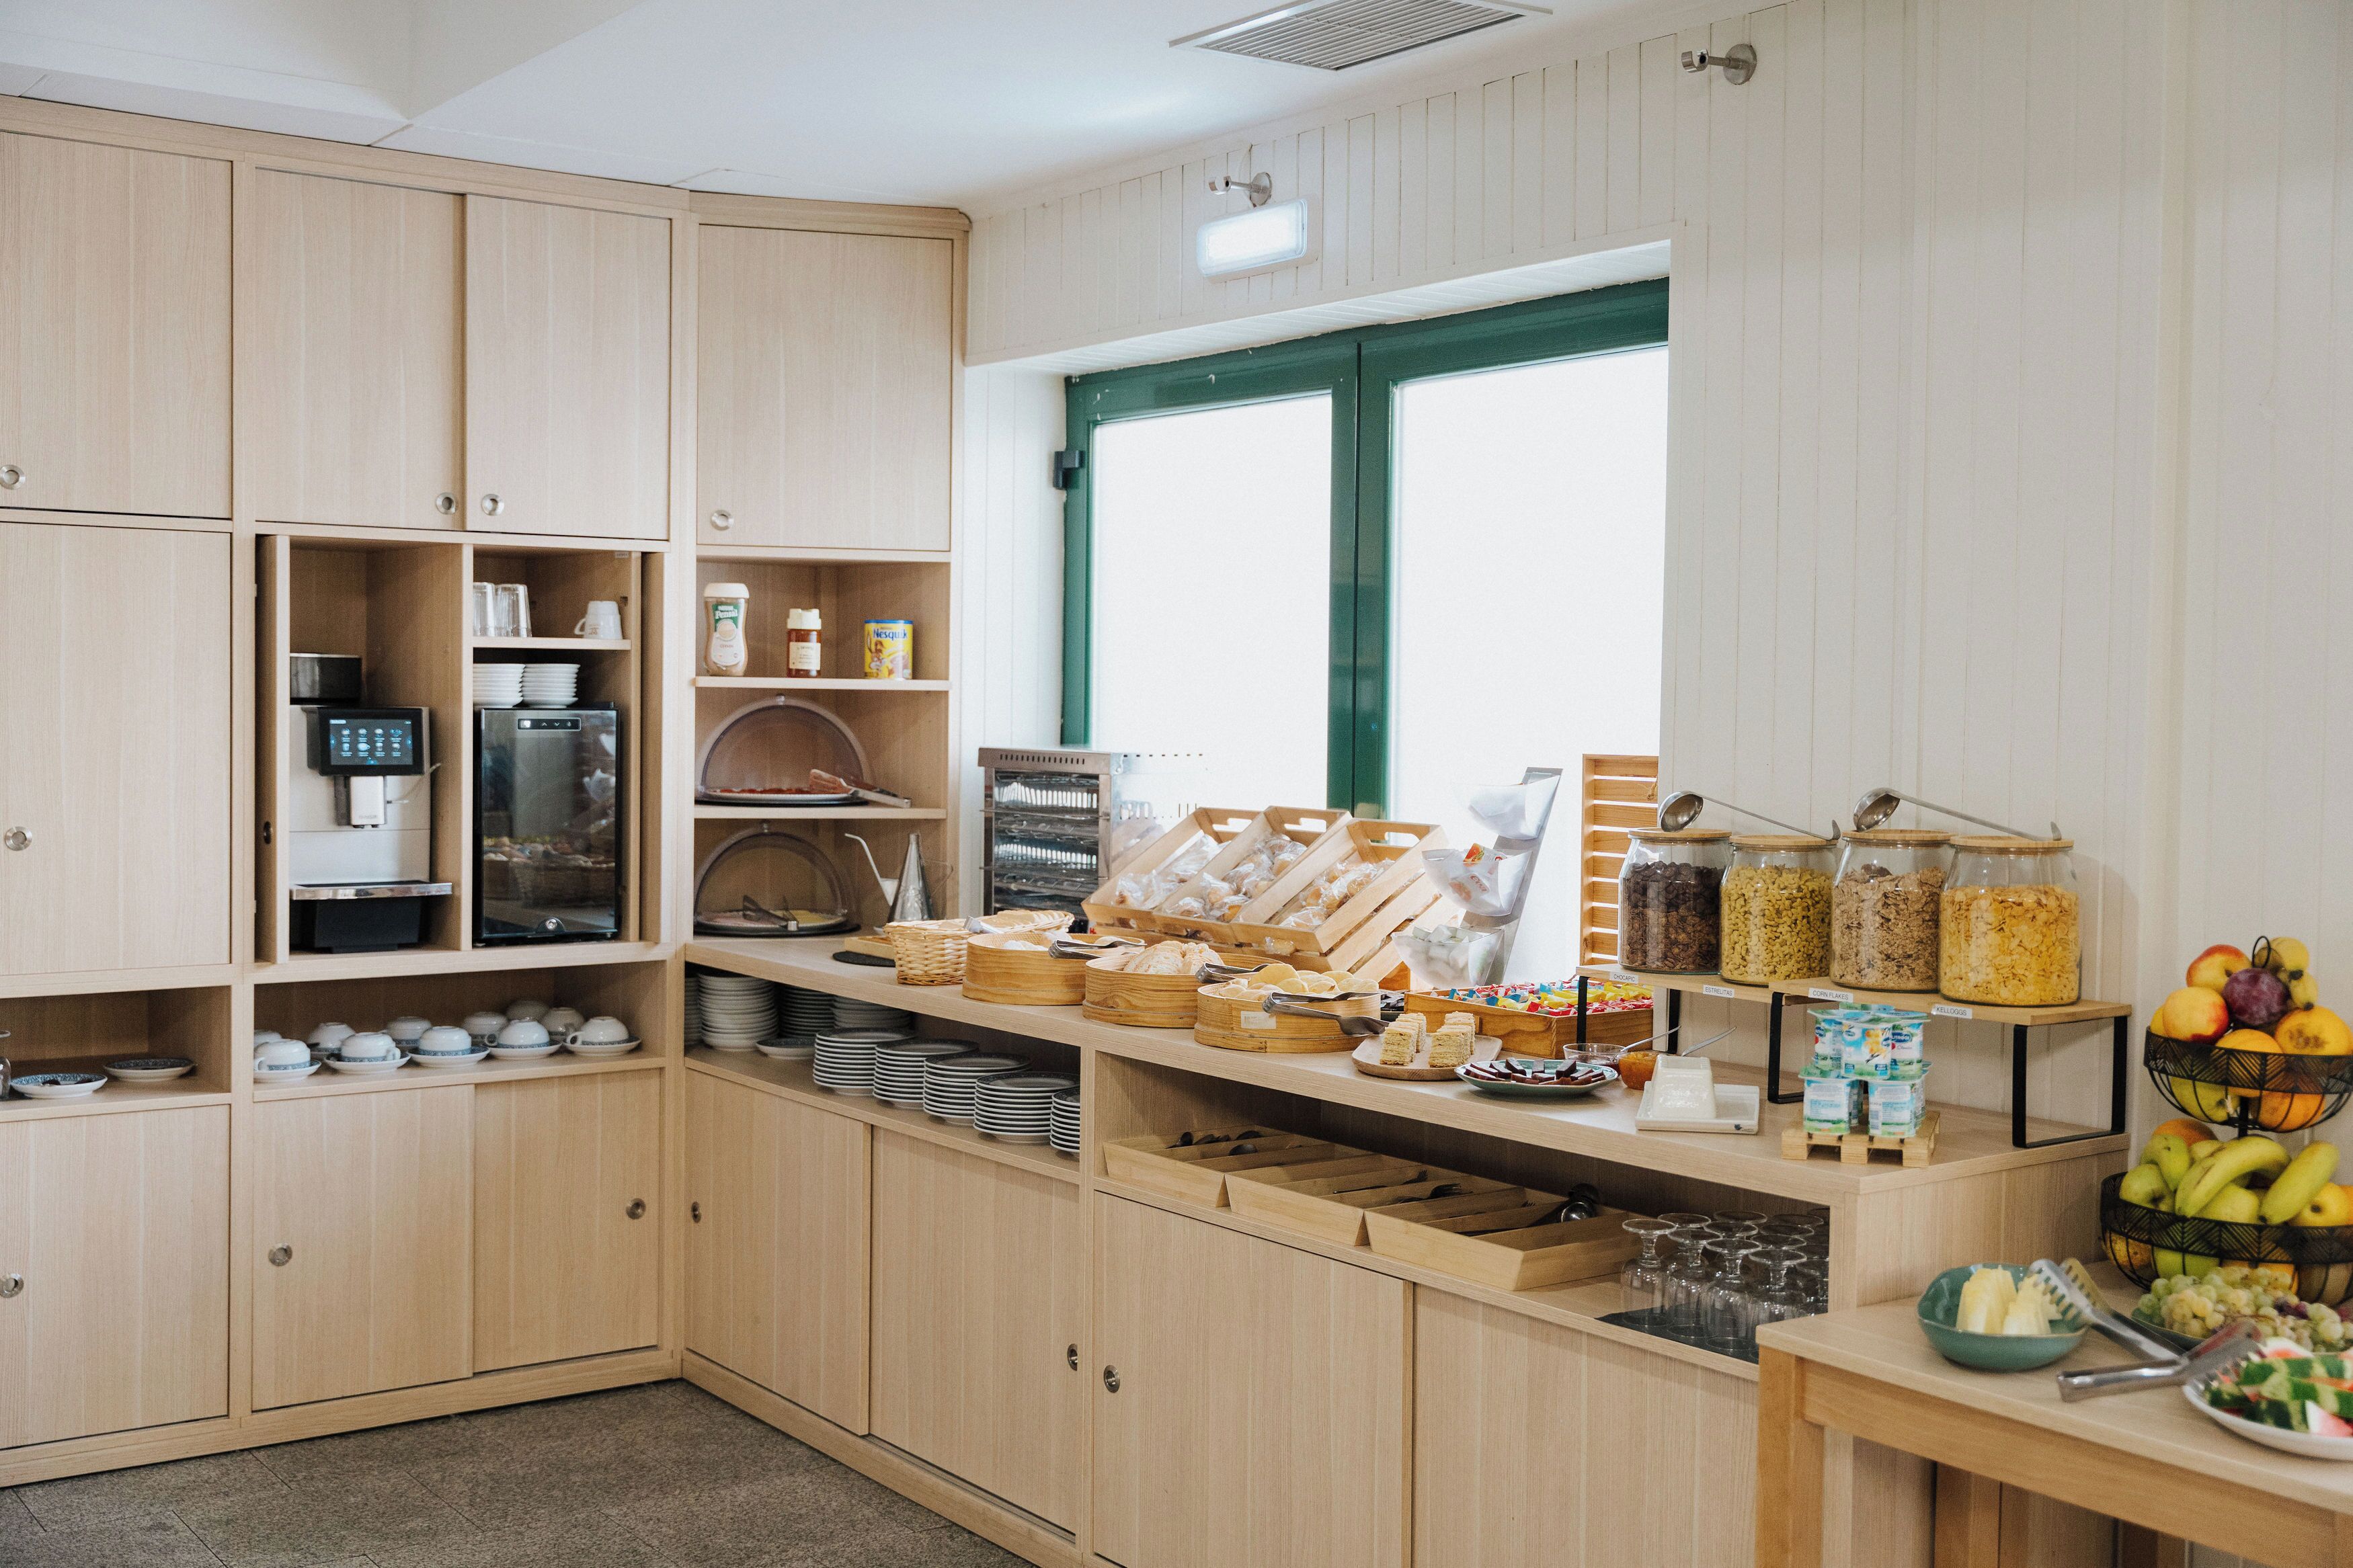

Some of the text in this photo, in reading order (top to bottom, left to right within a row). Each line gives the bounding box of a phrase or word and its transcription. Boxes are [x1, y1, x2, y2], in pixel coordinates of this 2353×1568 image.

[1613, 974, 1636, 982] CHOCAPIC
[1705, 987, 1733, 996] ESTRELITAS
[1829, 992, 1849, 1000] FLAKES
[1936, 1005, 1967, 1016] KELLOGGS
